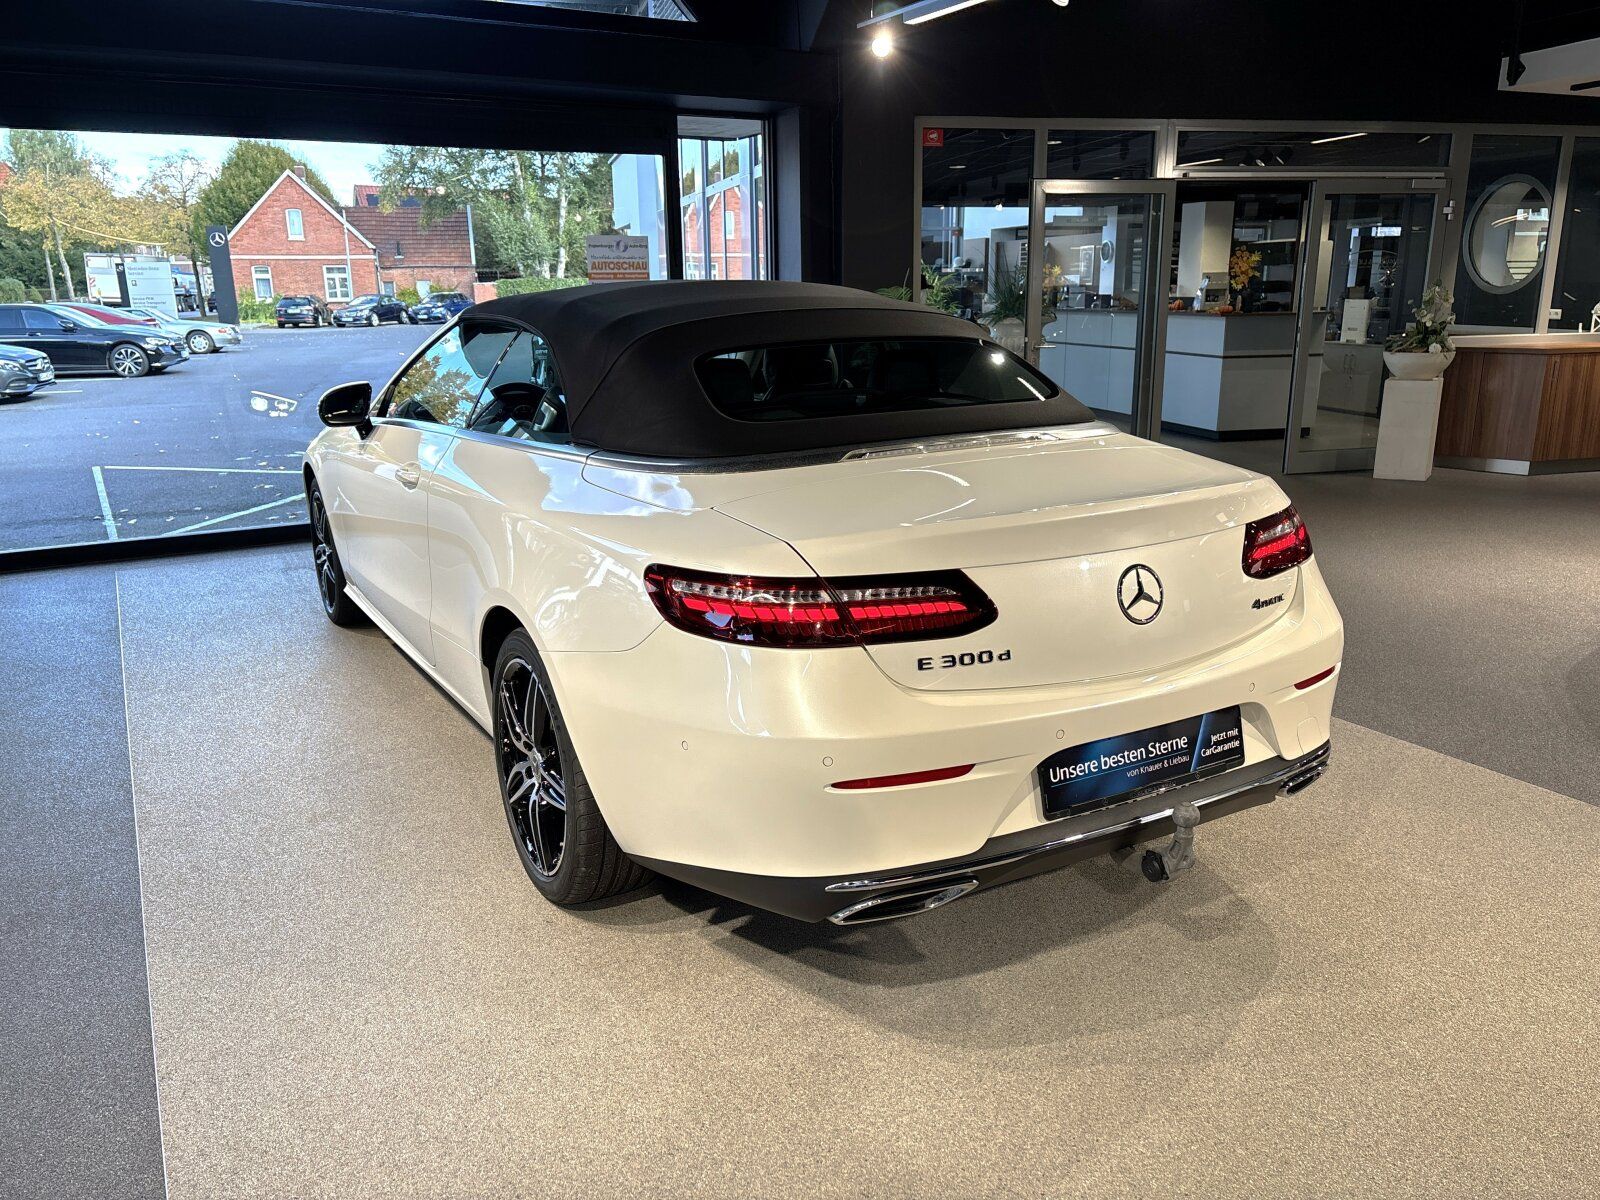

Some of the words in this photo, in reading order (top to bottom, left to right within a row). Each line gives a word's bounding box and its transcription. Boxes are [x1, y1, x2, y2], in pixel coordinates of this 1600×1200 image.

[591, 261, 647, 270] AUTOSCHAU
[917, 657, 934, 671] E
[1210, 730, 1226, 745] Jetzt
[1227, 728, 1239, 737] mit
[1201, 738, 1240, 757] CarGarantie
[1050, 759, 1099, 783] Unsere
[1100, 746, 1146, 770] besten
[1148, 736, 1188, 757] Sterne
[1126, 768, 1140, 778] von
[1140, 761, 1163, 774] Knauer
[1163, 758, 1169, 768] &
[1169, 754, 1190, 767] Liebau
